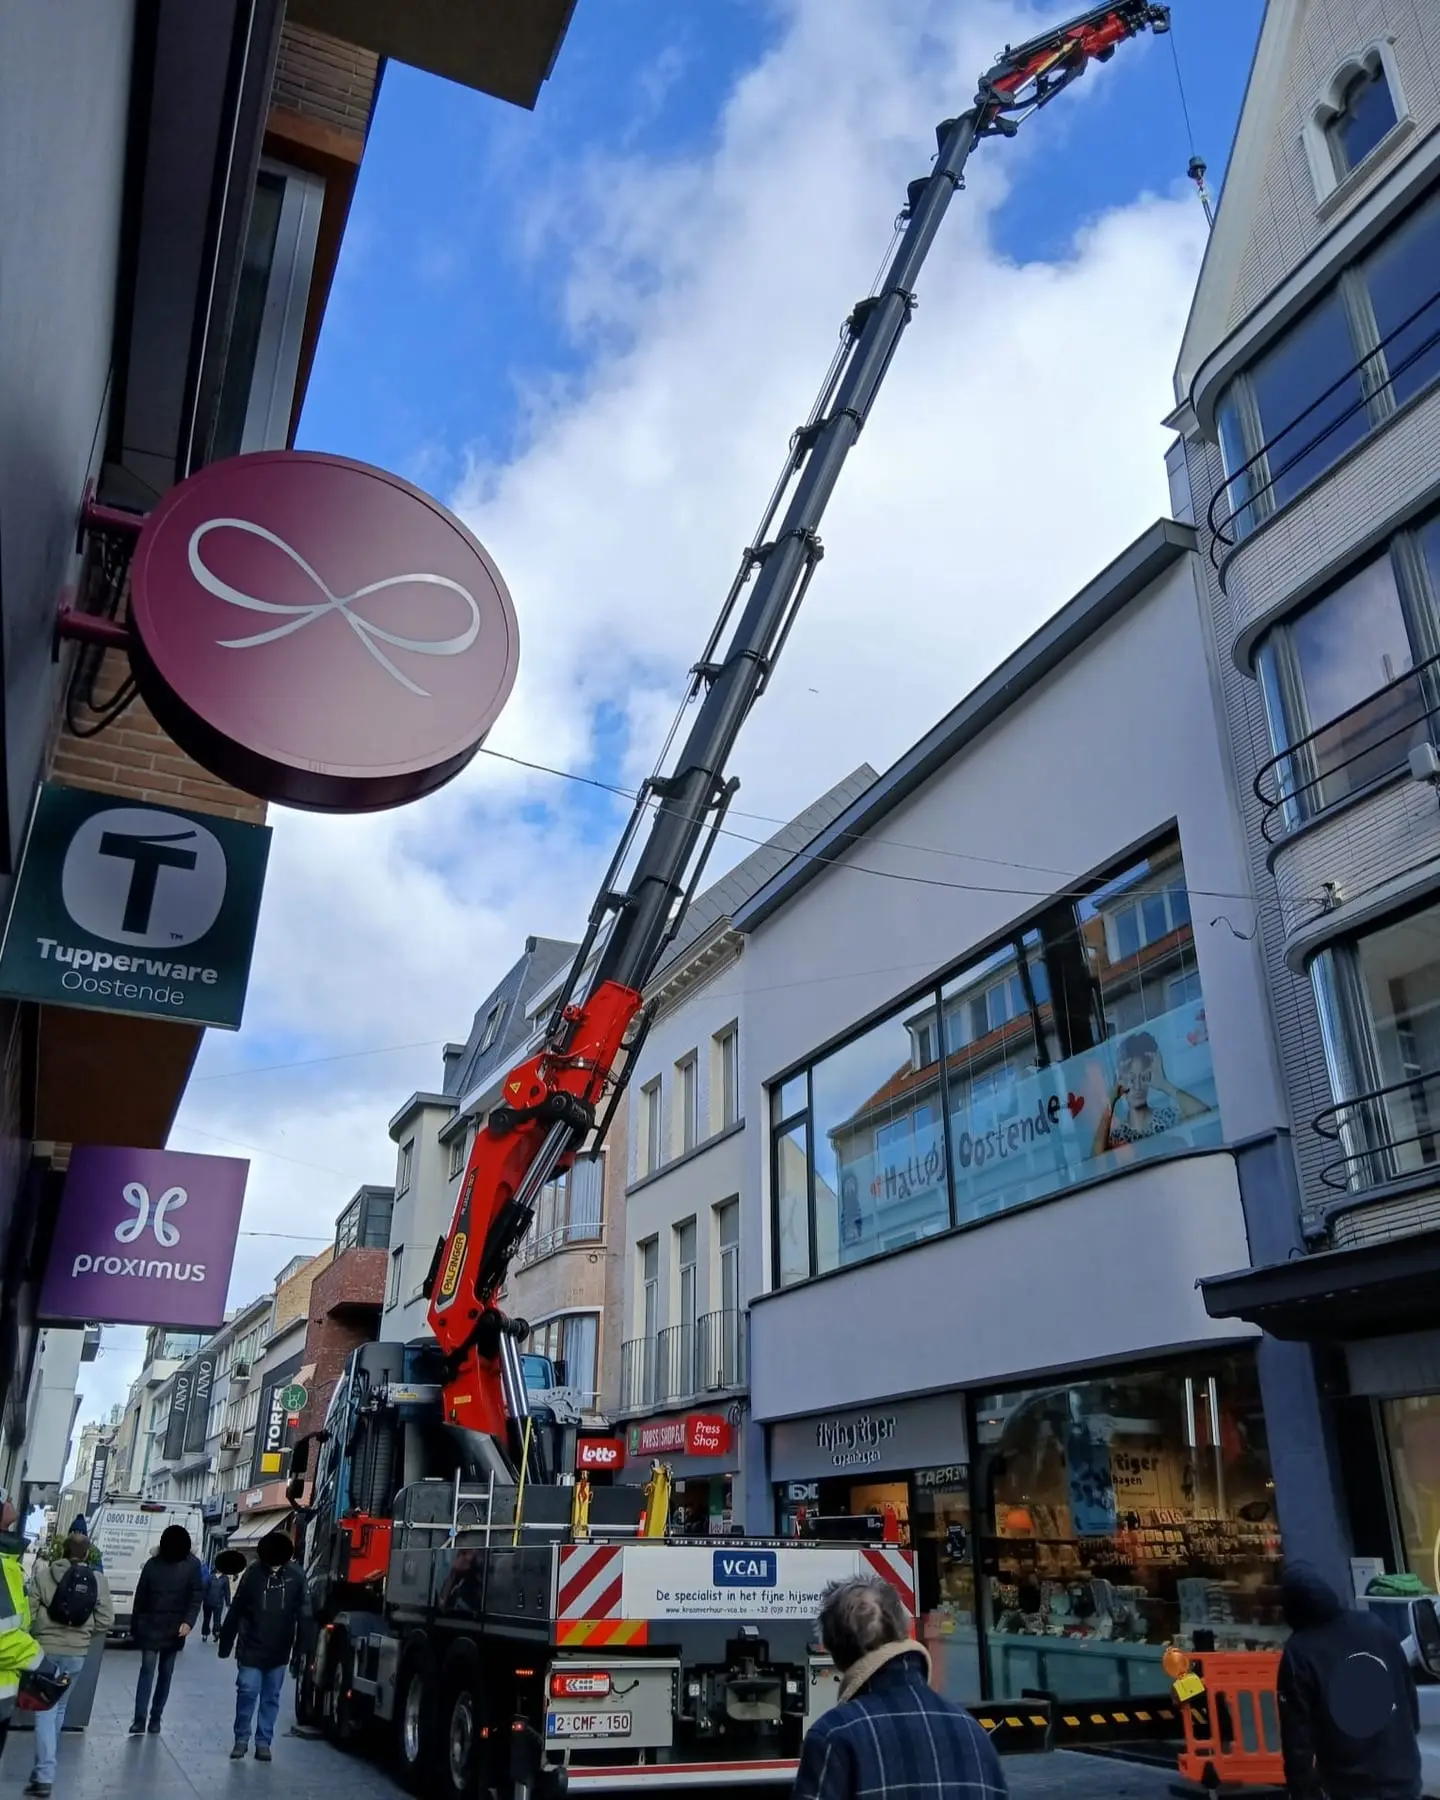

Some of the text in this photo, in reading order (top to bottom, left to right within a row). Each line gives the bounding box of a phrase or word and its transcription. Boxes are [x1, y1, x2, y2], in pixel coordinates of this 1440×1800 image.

[36, 937, 219, 985] Tupperware
[61, 970, 185, 1006] Oostende
[958, 1094, 1060, 1168] Oostende
[71, 1253, 207, 1282] proximus
[443, 1235, 465, 1291] PALFINGER
[174, 1377, 189, 1412] INNO
[195, 1360, 212, 1399] INNO
[266, 1387, 285, 1450] TORFS
[695, 1420, 721, 1434] Press
[816, 1415, 898, 1453] flying tiger
[642, 1428, 659, 1449] PRESS
[661, 1426, 675, 1446] SHOP
[693, 1434, 719, 1450] Shop
[1114, 1453, 1159, 1475] tiger
[722, 1559, 759, 1576] VCA
[656, 1589, 824, 1605] De specialist in het fijne hijswer
